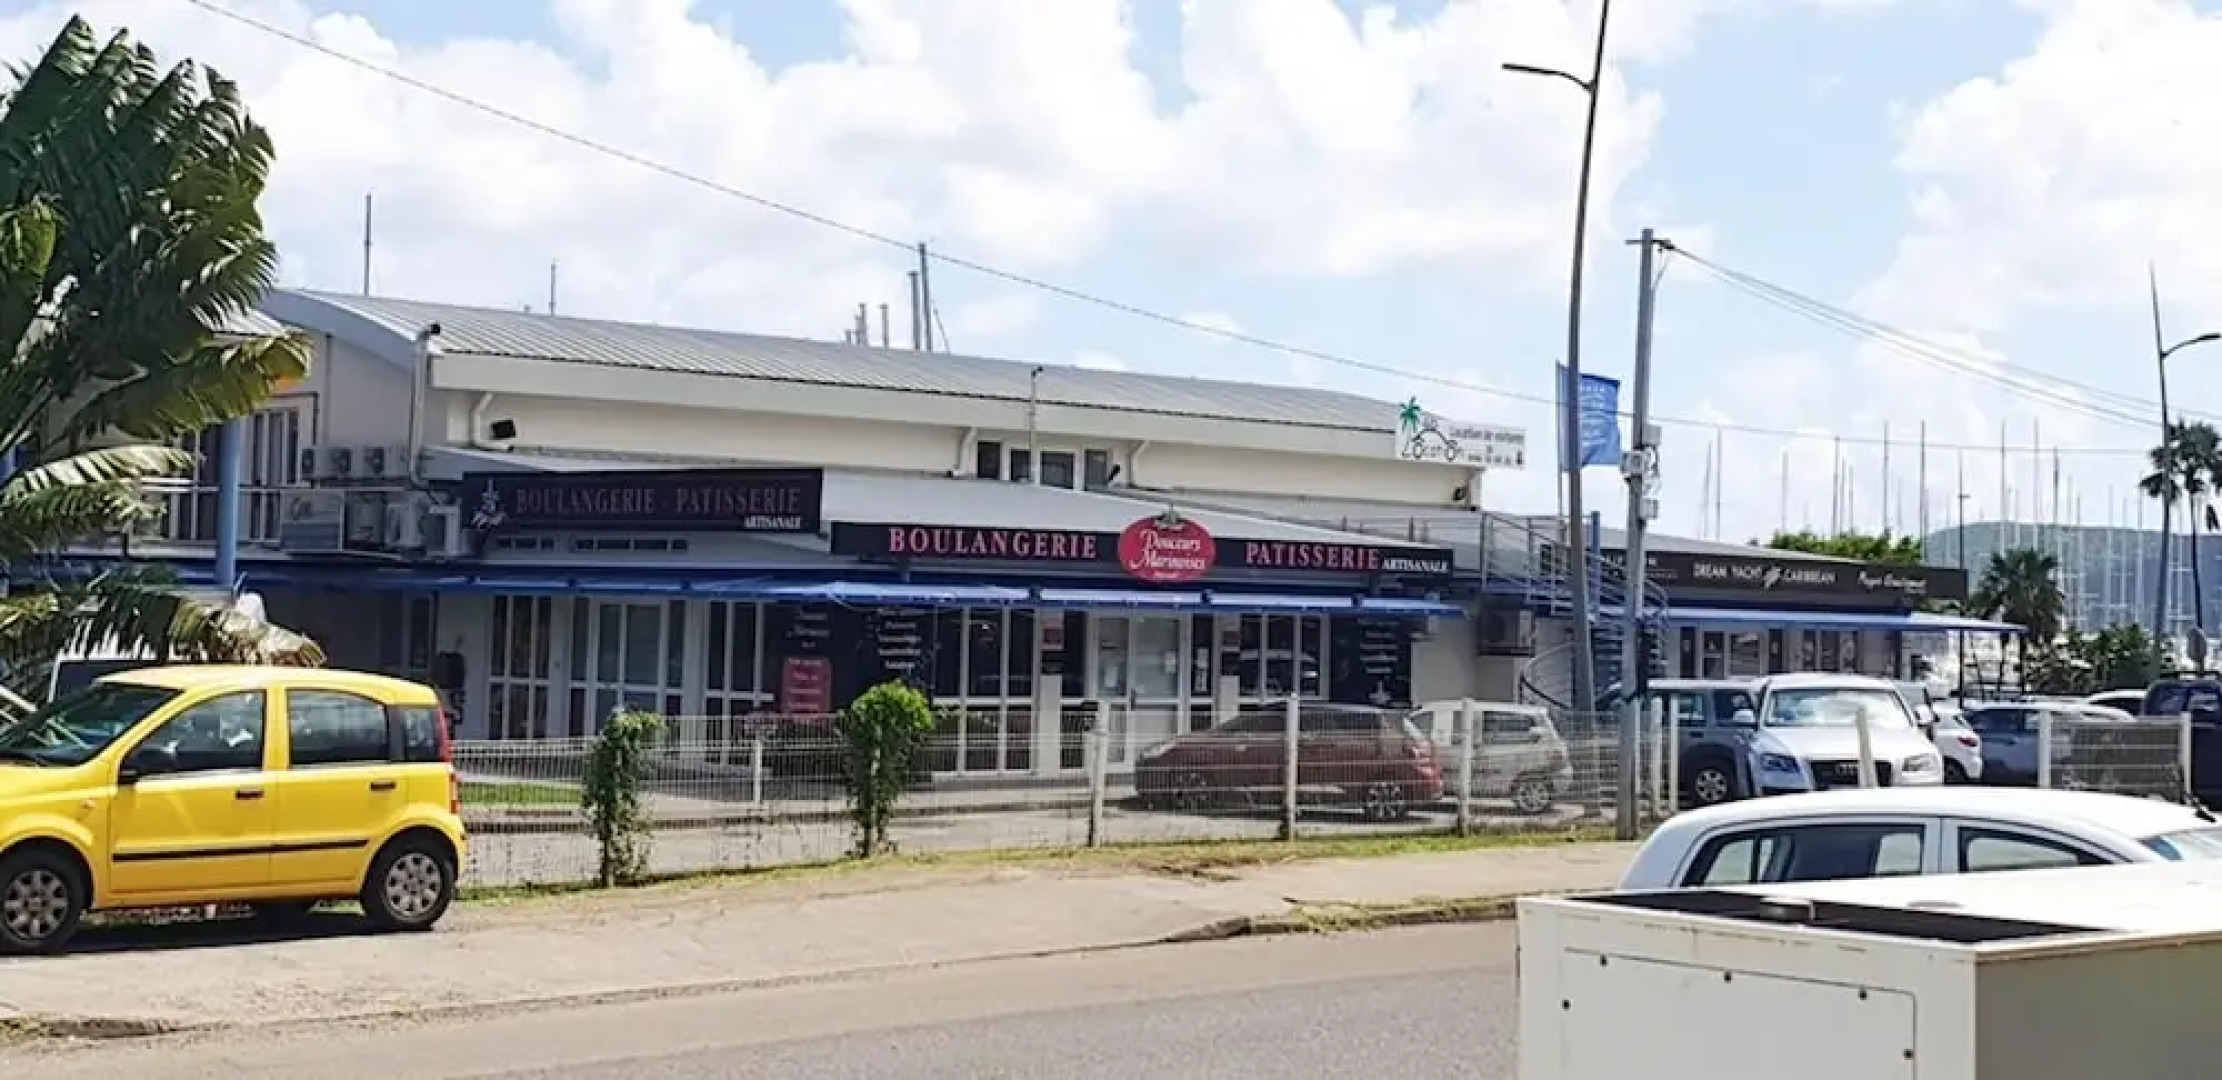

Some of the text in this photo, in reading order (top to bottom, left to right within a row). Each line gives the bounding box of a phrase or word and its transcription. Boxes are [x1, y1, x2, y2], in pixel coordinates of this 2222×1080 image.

[516, 487, 654, 515] BOULANGERIE
[677, 486, 801, 514] PATISSERIE
[743, 515, 801, 530] ARTISANALE
[889, 527, 1097, 559] BOULANGERIE
[1245, 541, 1449, 572] PATISSERIE ARTISANALE
[1692, 563, 1727, 579] DREAM
[1732, 565, 1761, 580] YACHT
